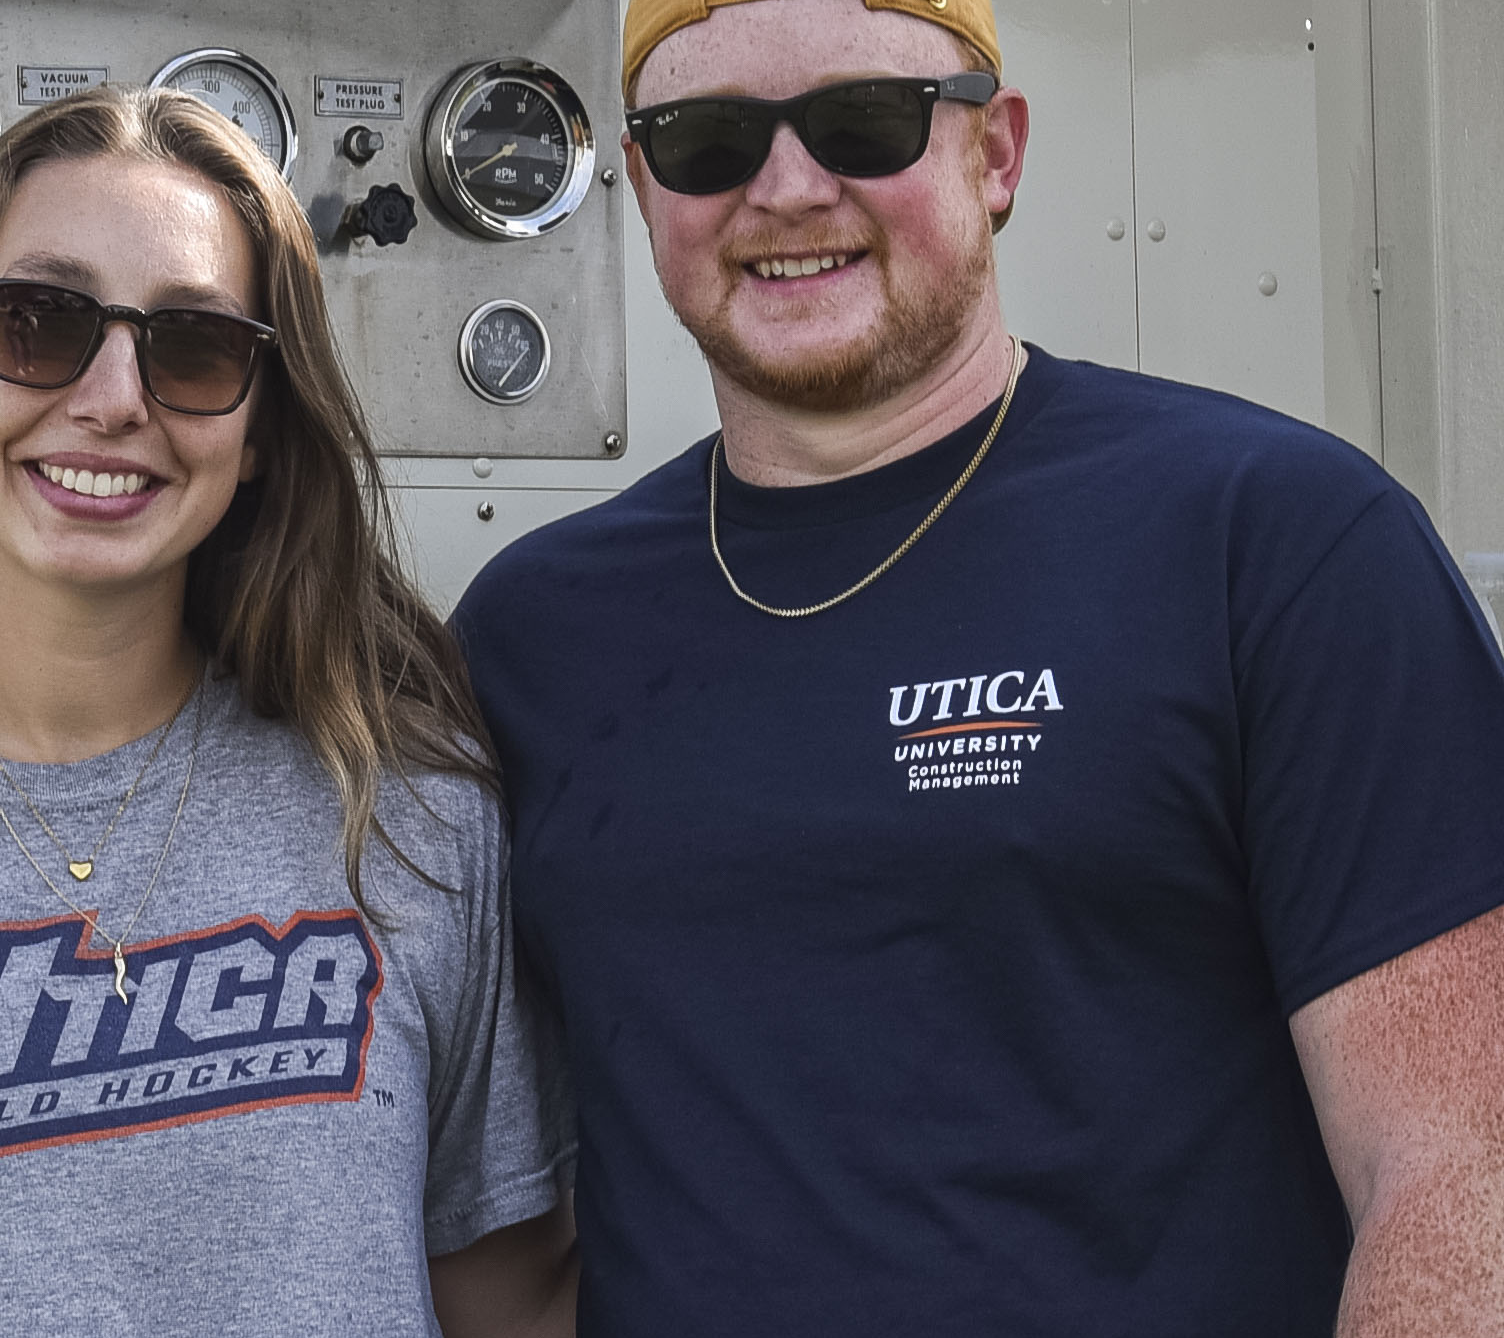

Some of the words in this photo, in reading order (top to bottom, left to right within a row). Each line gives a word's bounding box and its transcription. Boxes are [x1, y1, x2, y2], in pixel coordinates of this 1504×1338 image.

[40, 72, 89, 84] VACUUM
[40, 87, 61, 98] TEST
[335, 84, 383, 96] PRESSURE
[232, 101, 251, 114] 400
[335, 98, 355, 109] TEST
[359, 99, 385, 110] PLUG
[482, 101, 492, 112] 20
[516, 102, 526, 113] 30
[460, 131, 469, 142] 10
[540, 134, 550, 145] 40
[495, 168, 517, 179] RPM
[890, 668, 1064, 727] UTICA
[894, 734, 1042, 762] UNIVERSITY
[908, 757, 1023, 778] Construction
[908, 771, 1021, 793] Management
[98, 1047, 328, 1105] HOCKEY
